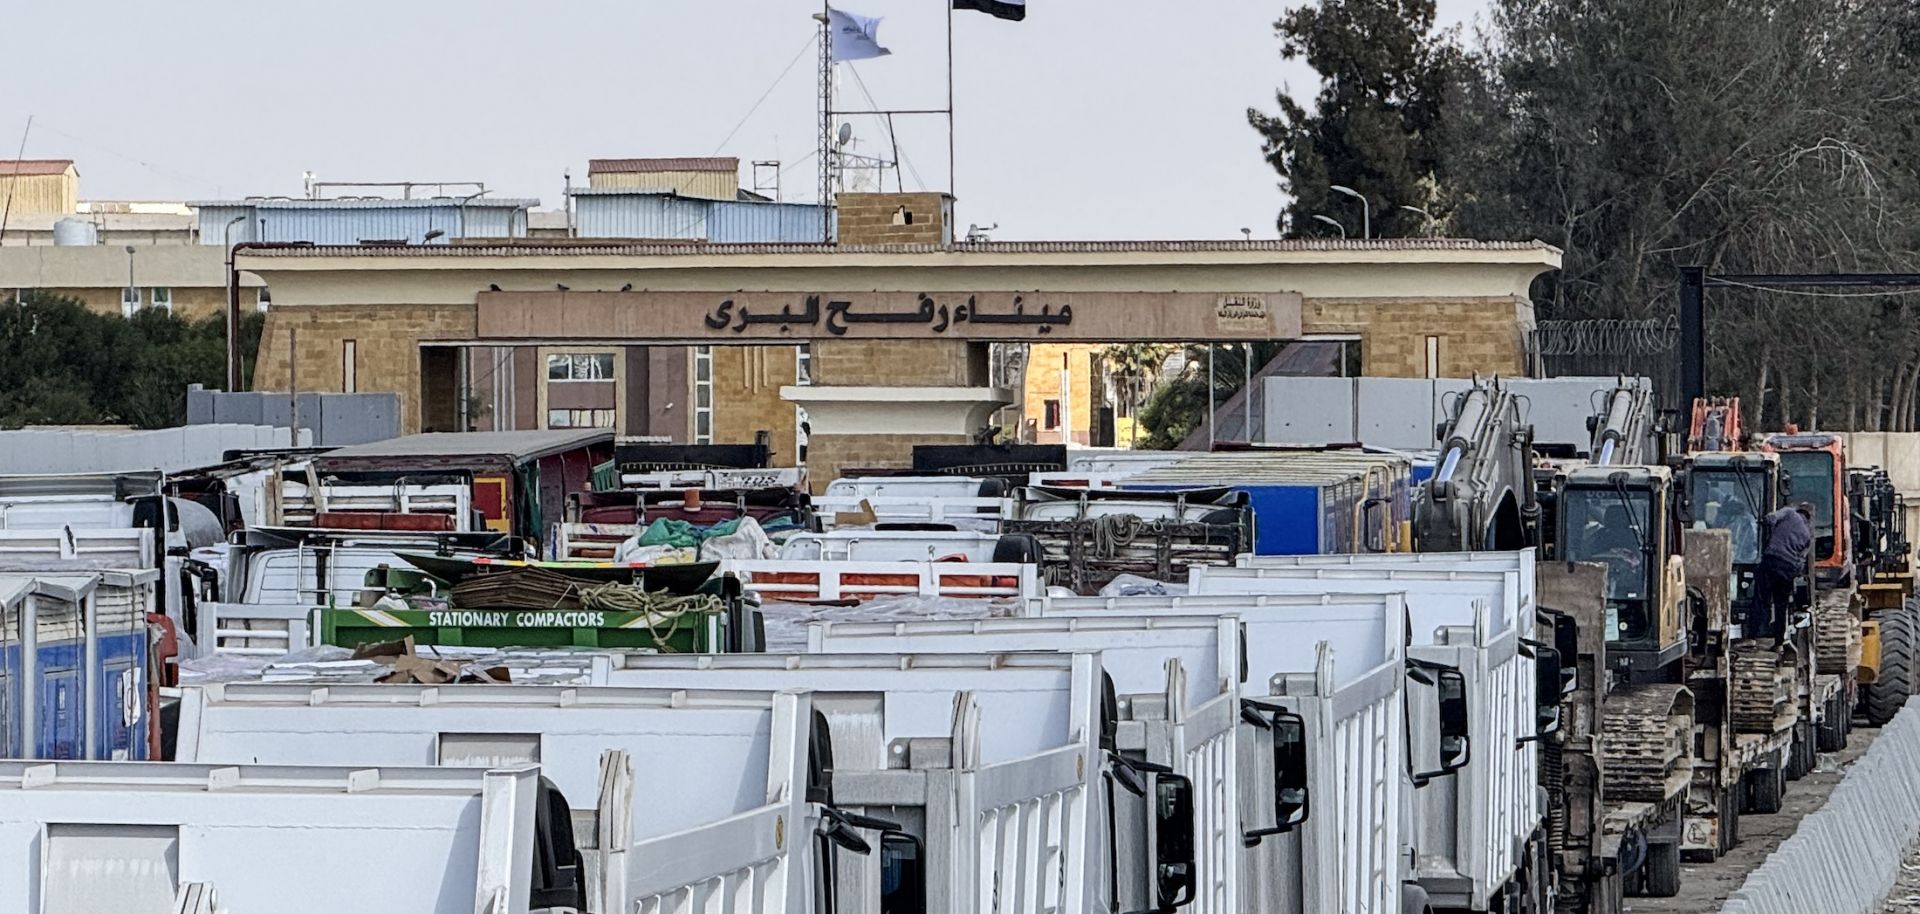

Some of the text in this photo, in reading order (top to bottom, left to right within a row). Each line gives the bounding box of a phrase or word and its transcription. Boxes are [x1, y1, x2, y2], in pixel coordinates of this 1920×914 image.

[825, 292, 949, 334] رفح
[953, 295, 1072, 334] ميناء
[429, 612, 605, 627] STATIONARY COMPACTORS
